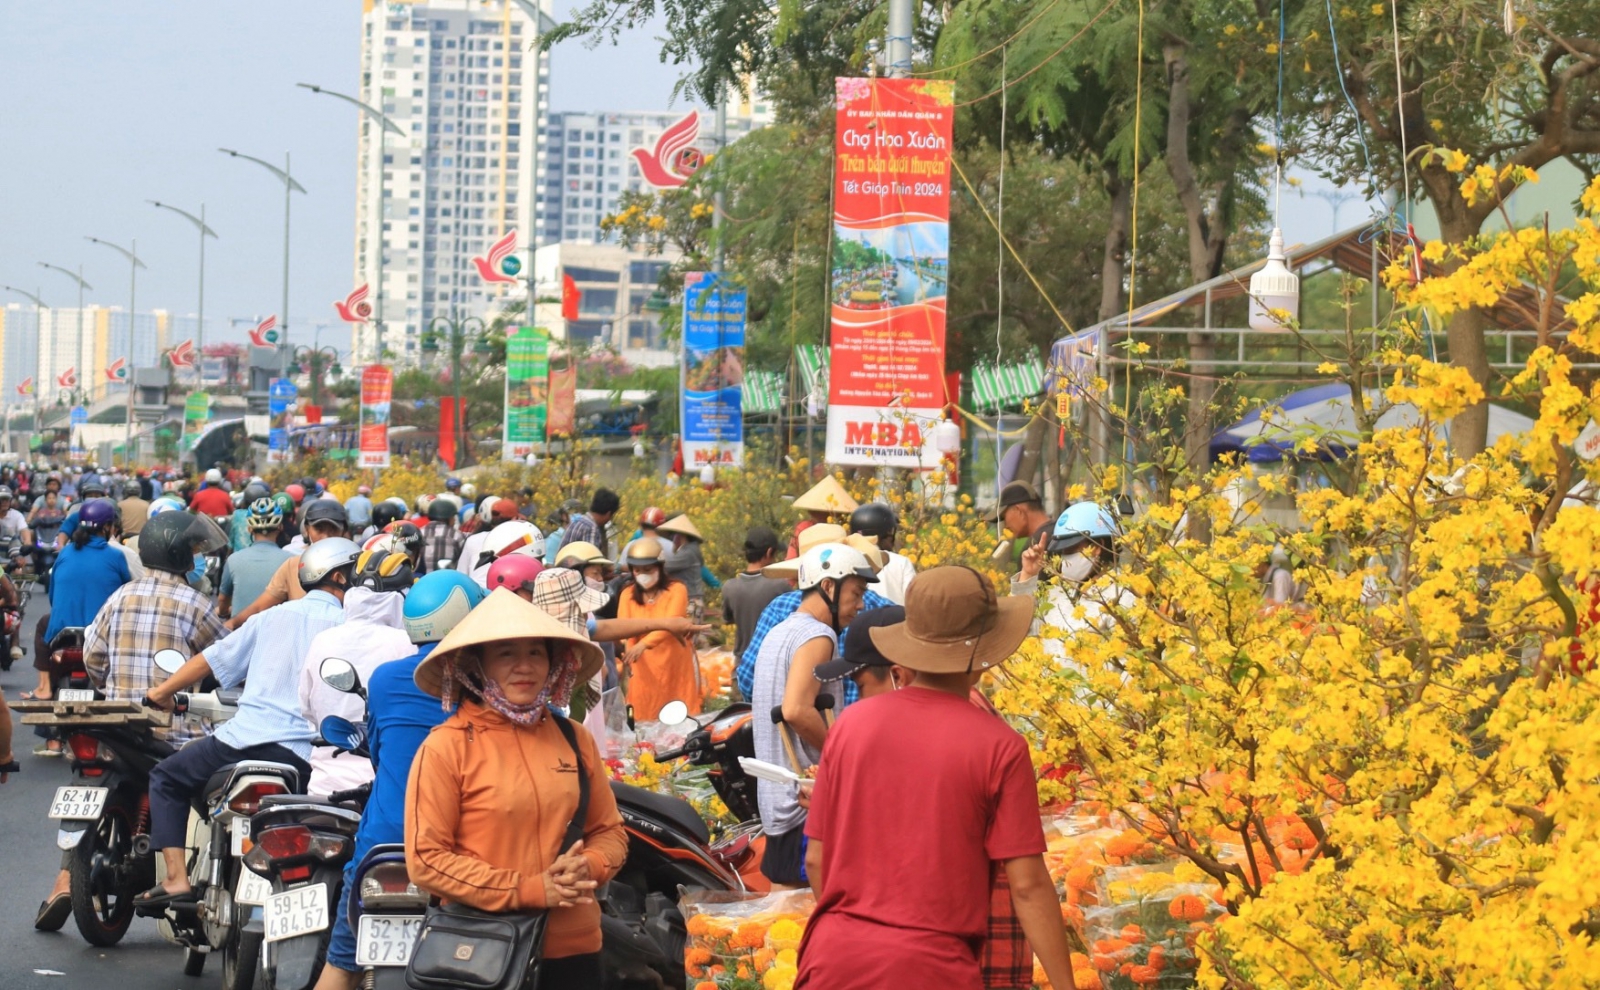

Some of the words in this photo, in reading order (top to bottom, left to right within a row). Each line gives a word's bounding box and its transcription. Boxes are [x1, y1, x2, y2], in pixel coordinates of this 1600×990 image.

[843, 129, 870, 150] Chợ
[875, 130, 903, 147] Hoa
[907, 131, 945, 149] Xuân
[843, 180, 858, 194] Tết
[862, 181, 888, 198] Giáp
[914, 183, 942, 196] 2024
[845, 421, 922, 447] MBA
[62, 789, 98, 802] 62-N1
[53, 803, 100, 816] 593.87
[274, 889, 317, 916] 59-L2
[270, 908, 323, 937] 484.67
